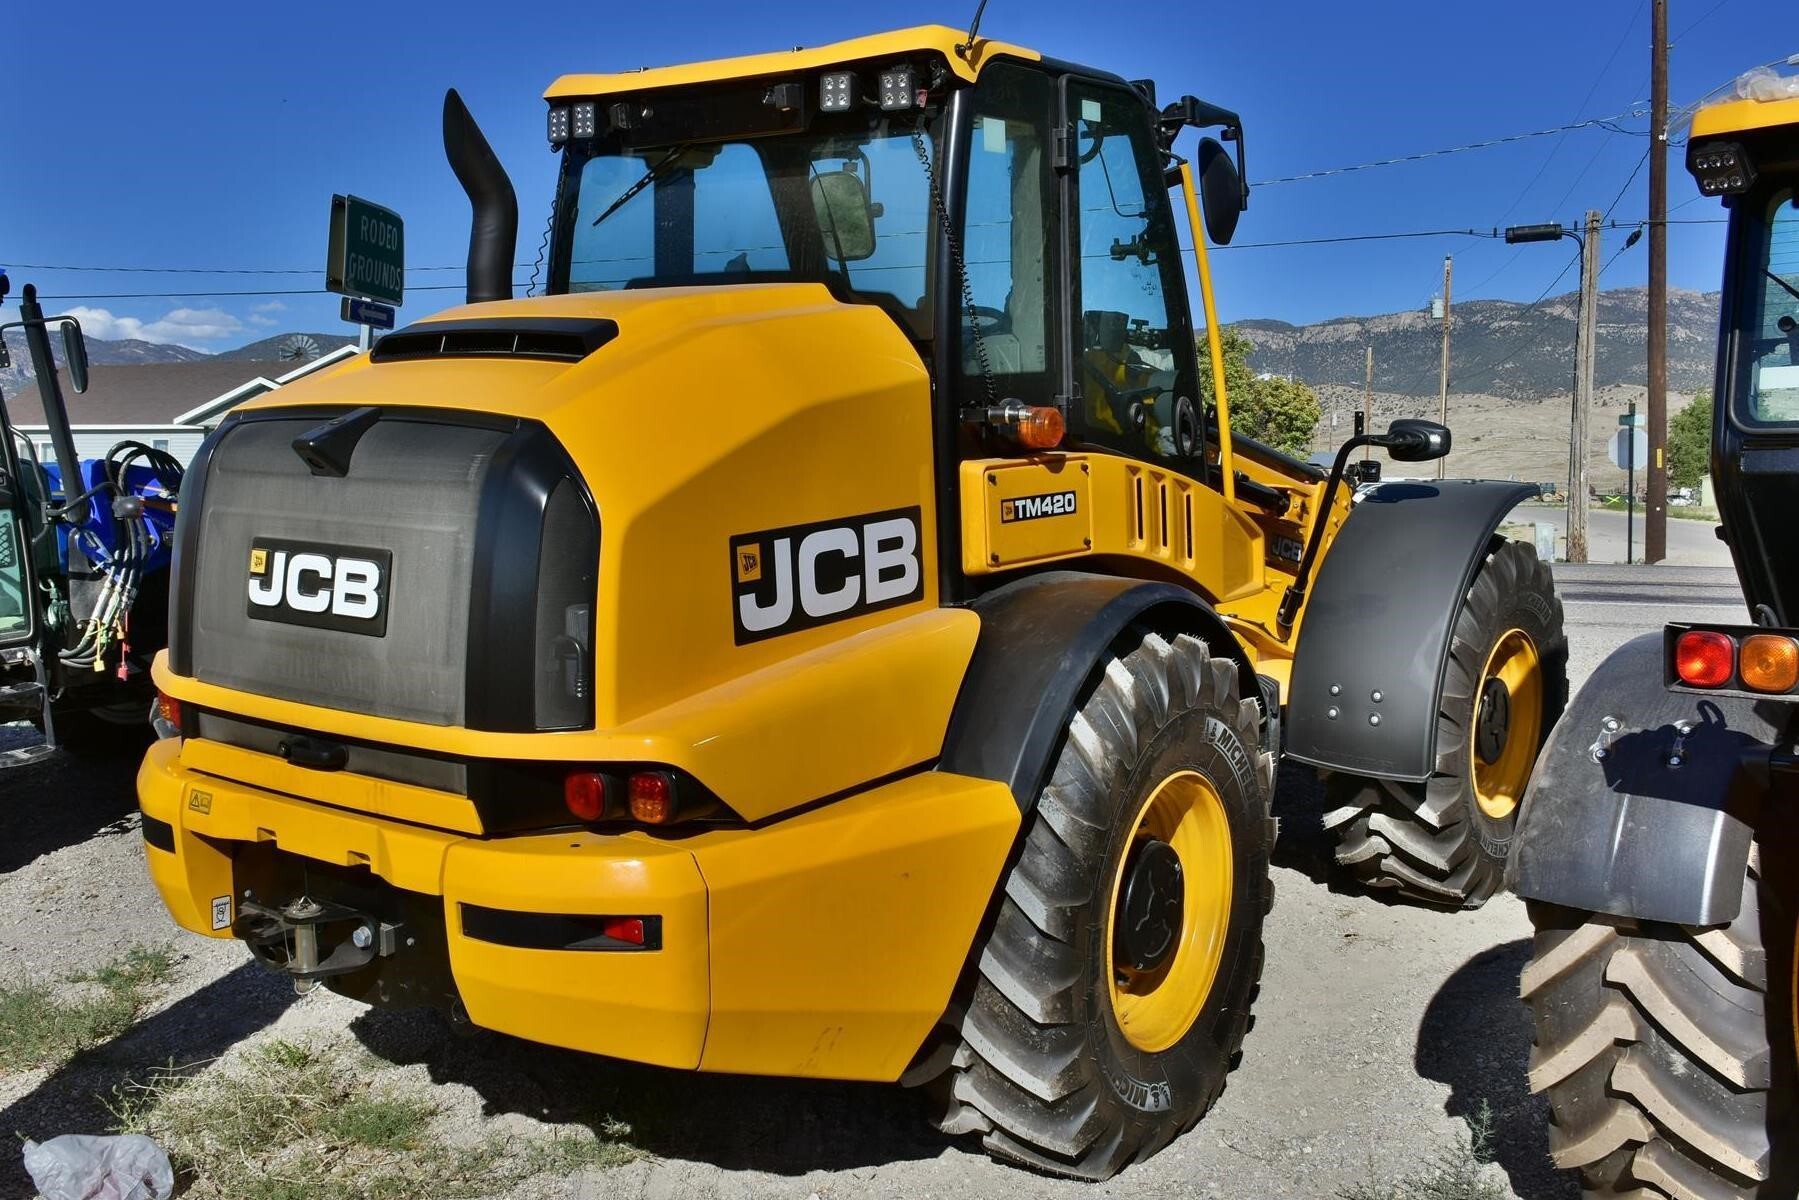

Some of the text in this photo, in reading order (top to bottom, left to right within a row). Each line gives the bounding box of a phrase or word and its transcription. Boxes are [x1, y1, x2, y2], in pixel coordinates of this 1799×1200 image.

[360, 215, 398, 249] RODEO
[350, 252, 401, 292] GROUNDS
[1015, 493, 1075, 518] TM420
[248, 551, 380, 619] JCB
[739, 517, 920, 632] JCB
[1216, 727, 1257, 800] MICHE
